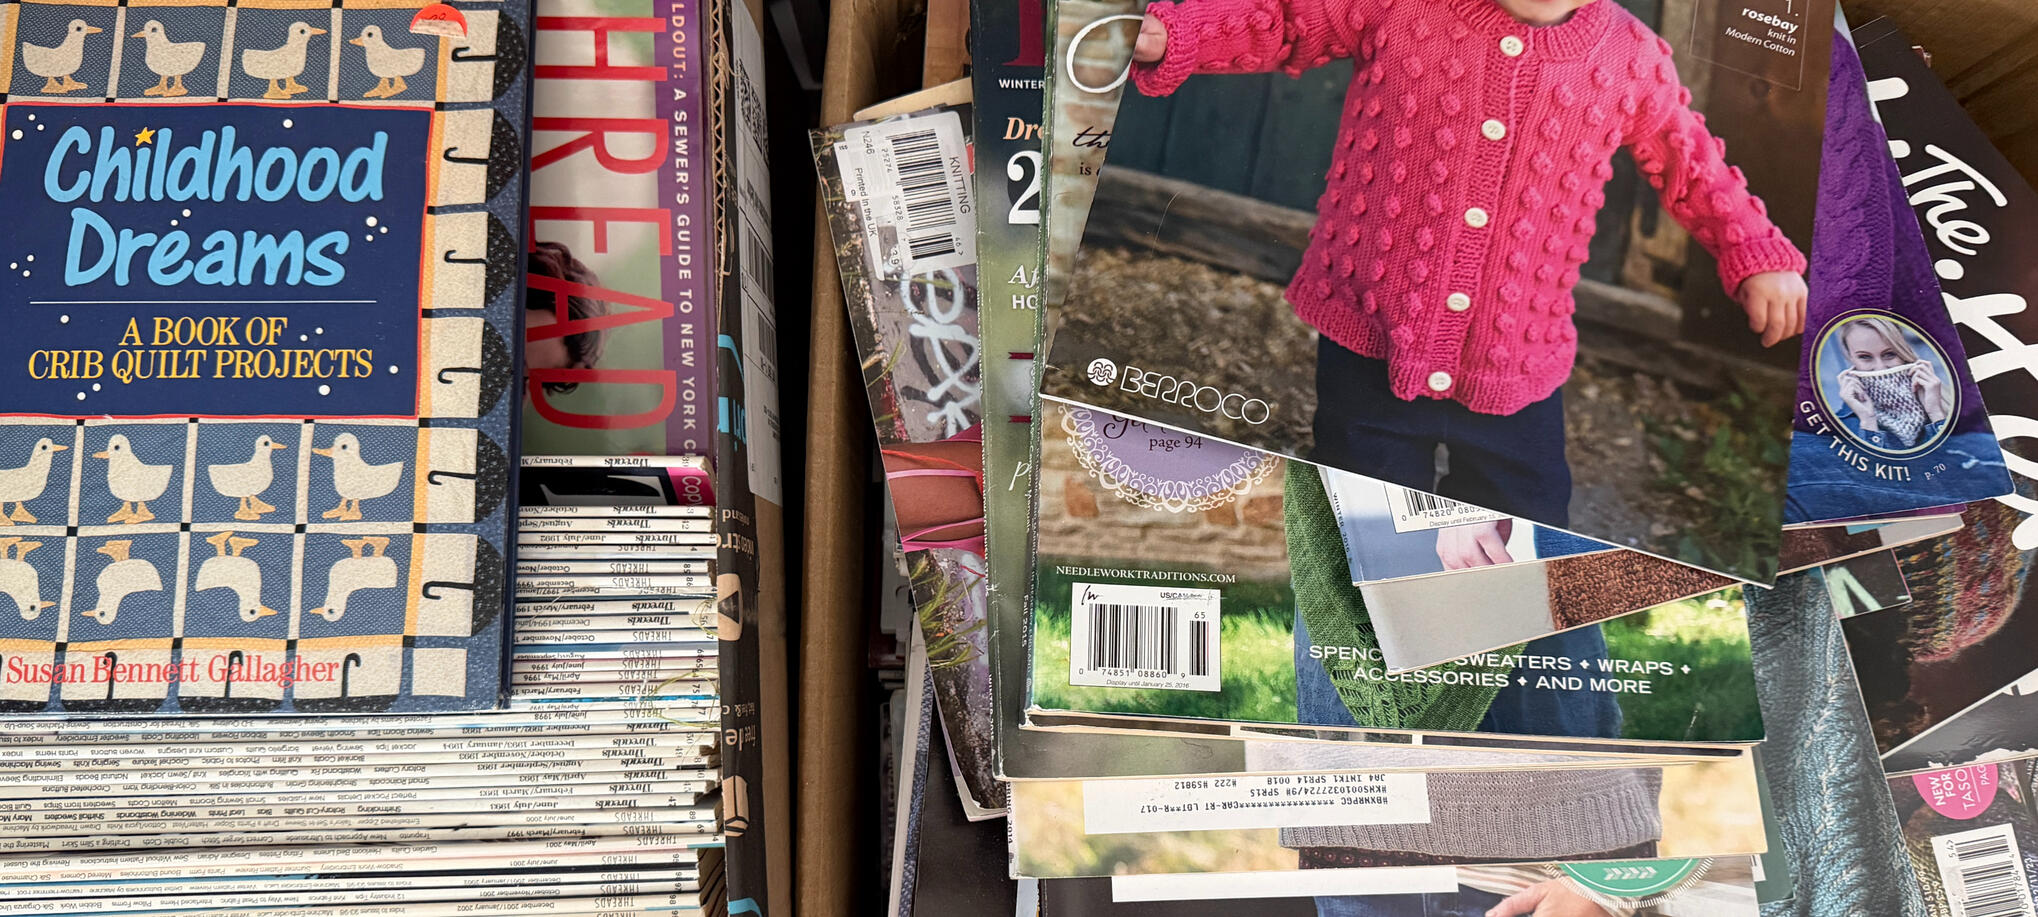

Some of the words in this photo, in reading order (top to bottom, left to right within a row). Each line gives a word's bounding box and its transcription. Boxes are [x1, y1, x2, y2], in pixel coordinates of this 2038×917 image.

[1742, 6, 1799, 34] rosebay
[672, 3, 687, 80] LDOUT:
[1725, 26, 1763, 48] Modern
[1763, 40, 1796, 57] Cotton
[1767, 29, 1785, 43] knit
[1786, 34, 1797, 45] in
[999, 79, 1044, 90] WINTER
[673, 88, 686, 101] A
[674, 111, 689, 204] SEWER'S
[44, 125, 388, 202] Childhood
[1080, 162, 1091, 175] is
[948, 156, 971, 214] KNITTING
[855, 168, 867, 197] Printed
[868, 223, 878, 237] UK
[527, 15, 676, 456] HREAD
[64, 208, 349, 287] Dreams
[677, 215, 690, 280] GUIDE
[679, 289, 693, 313] TO
[119, 317, 143, 346] A
[151, 317, 242, 346] BOOK
[246, 317, 289, 345] OF
[681, 323, 694, 367] NEW
[29, 350, 104, 380] CRIB
[112, 349, 207, 383] QUILT
[213, 348, 373, 379] PROJECTS
[1120, 366, 1270, 424] BERROCO
[683, 377, 696, 431] YORK
[1149, 436, 1181, 452] page
[1184, 436, 1202, 449] 94
[1799, 399, 1831, 436] GET
[1829, 435, 1870, 471] THIS
[1875, 462, 1912, 482] KIT!
[1934, 462, 1947, 474] 70
[604, 458, 650, 467] Threads
[1333, 492, 1345, 528] WINTER
[1424, 509, 1451, 519] 74820
[607, 519, 650, 528] Threads
[563, 534, 606, 542] June/July
[635, 535, 679, 543] Threads
[609, 563, 649, 573] THREADS
[1056, 565, 1236, 583] NEEDLEWORKTRADITIONS.COM
[612, 577, 652, 587] THREADS
[632, 602, 675, 611] Threads
[627, 616, 671, 625] Threads
[521, 634, 595, 642] October/November
[632, 631, 672, 641] THREADS
[622, 659, 661, 669] THREADS
[1309, 645, 1383, 660] SPENC
[1455, 655, 1572, 670] SWEATERS
[1596, 659, 1673, 675] WRAPS
[6, 656, 86, 683] Susan
[92, 652, 200, 683] Bennett
[208, 654, 340, 689] Gallagher
[550, 662, 584, 670] June/July
[544, 673, 581, 681] April/May
[618, 670, 657, 679] THREADS
[1102, 669, 1130, 677] 74851
[1138, 670, 1167, 678] 08860
[1353, 667, 1510, 687] ACCESSORIES
[1535, 676, 1585, 691] AND
[1589, 678, 1652, 695] MORE
[521, 687, 581, 695] February/March
[554, 711, 587, 719] June/July
[55, 734, 98, 742] Embroidery
[612, 737, 656, 746] Threads
[602, 748, 645, 758] Threads
[620, 757, 664, 766] Threads
[542, 773, 587, 781] April/May
[623, 771, 668, 780] Threads
[1267, 777, 1290, 785] 0018
[1942, 773, 1955, 797] FOR
[70, 785, 111, 793] Crocheted
[608, 784, 653, 793] Threads
[1928, 777, 1946, 806] NEW
[1955, 769, 1976, 811] TASO
[357, 805, 402, 813] Shirtmaking
[595, 800, 638, 808] Threads
[44, 813, 77, 821] Sweaters
[162, 810, 197, 819] Widening
[228, 809, 246, 817] Leaf
[615, 812, 654, 822] THREADS
[622, 826, 662, 834] THREADS
[637, 836, 677, 845] THREADS
[594, 897, 634, 907] THREADS
